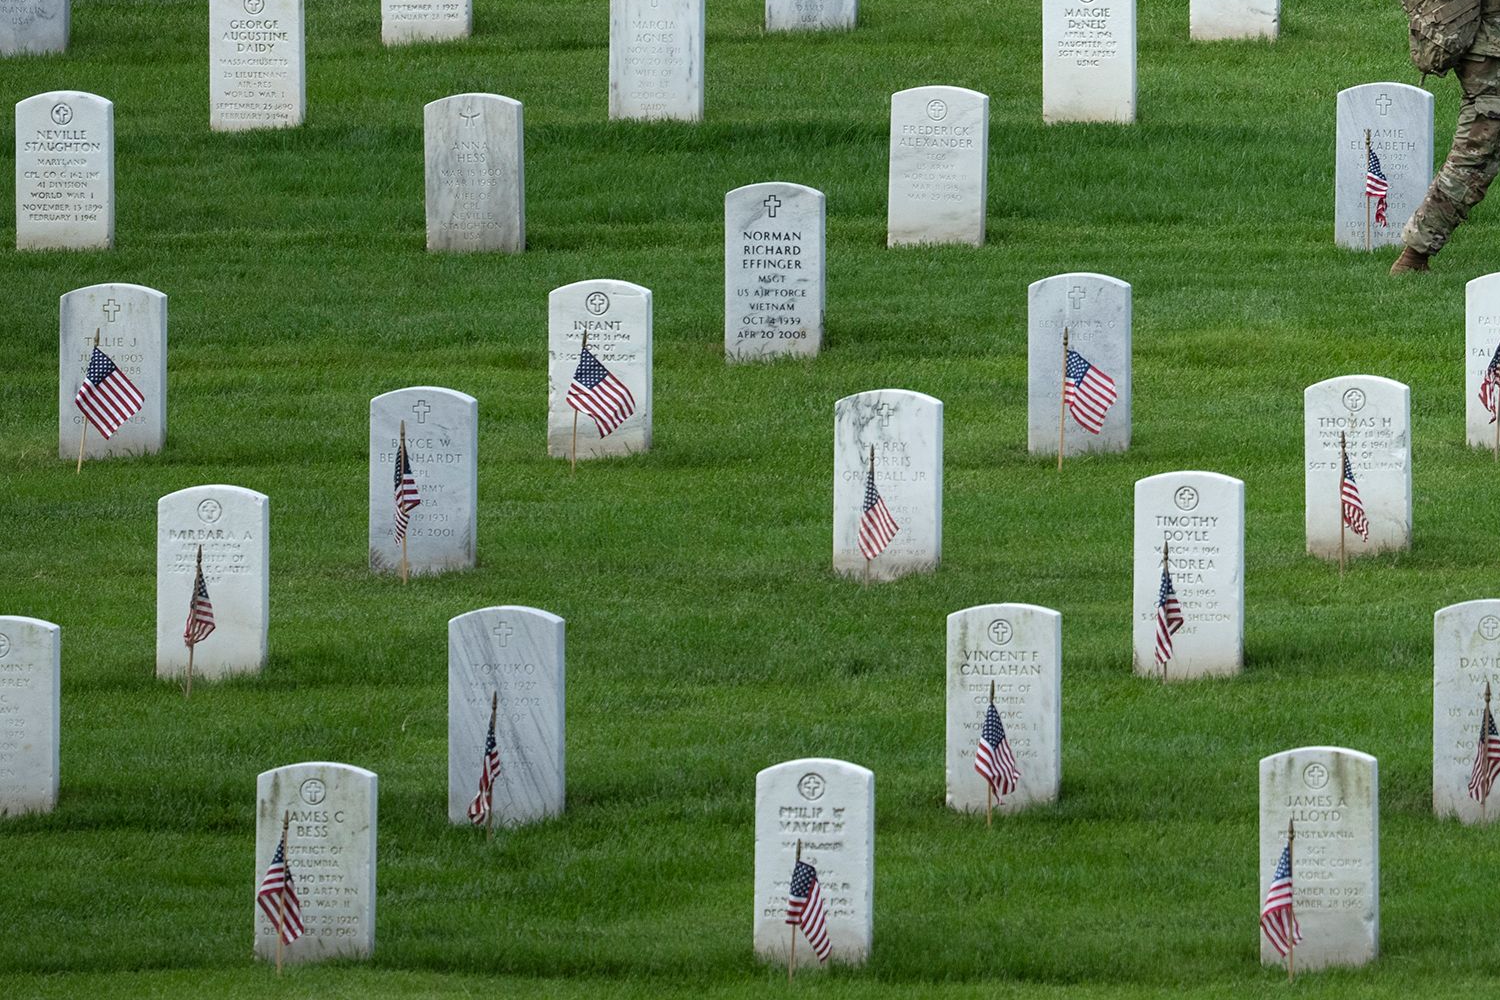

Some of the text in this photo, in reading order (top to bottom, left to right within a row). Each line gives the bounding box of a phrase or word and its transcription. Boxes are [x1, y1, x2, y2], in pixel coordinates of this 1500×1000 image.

[230, 19, 278, 29] GEORGE
[223, 31, 288, 41] AUGUSTINE
[237, 43, 275, 52] DAIDY
[36, 129, 86, 140] NEVILLE
[903, 125, 969, 135] FREDERICK
[24, 141, 100, 152] STAUGHTON
[451, 141, 488, 151] ANNA
[900, 137, 973, 147] ALEXANDER
[457, 153, 486, 163] HESS
[743, 231, 801, 241] NORMAN
[743, 245, 801, 255] RICHARD
[742, 259, 801, 269] EFFINGER
[758, 275, 785, 283] MSGT
[737, 289, 806, 297] US AIR FORCE
[749, 303, 795, 311] VIETNAM
[574, 320, 621, 330] INFANT
[738, 330, 807, 339] APR 20 2008
[1320, 417, 1392, 428] THOMAS H
[1155, 515, 1219, 527] TIMOTHY
[1163, 530, 1210, 541] DOYLE
[1158, 559, 1216, 570] ANDREA
[963, 650, 1038, 661] VINCENT F
[960, 664, 1041, 675] CALLAHAN
[1284, 795, 1349, 807] JAMES A
[281, 811, 345, 824] AMES C
[1292, 810, 1341, 822] LLOYD
[296, 826, 329, 838] BESS
